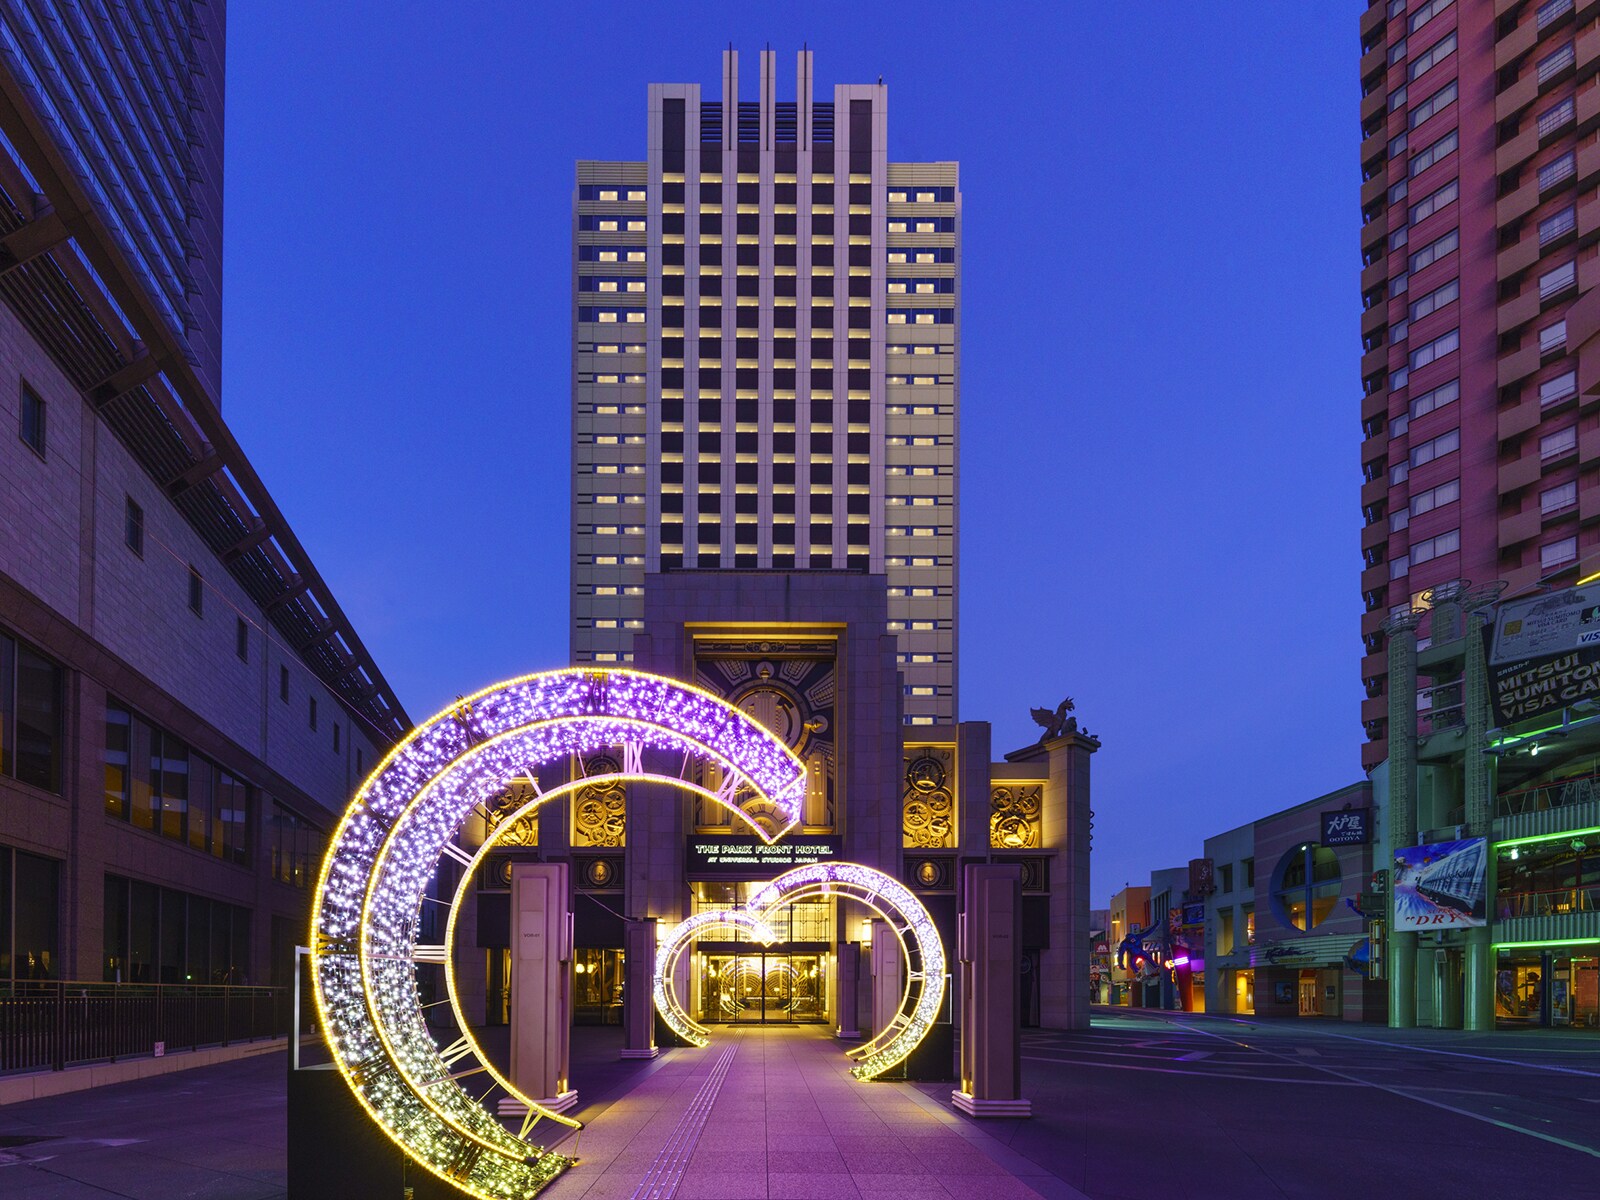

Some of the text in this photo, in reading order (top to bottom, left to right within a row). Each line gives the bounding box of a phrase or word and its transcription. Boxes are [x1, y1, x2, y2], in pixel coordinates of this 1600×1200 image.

[1581, 631, 1600, 643] VIS
[1497, 652, 1580, 693] MITSUI
[1501, 676, 1600, 720] VISA CA
[1327, 814, 1363, 835] 大戸屋
[695, 845, 833, 855] THE PARK FRONT HOTEL
